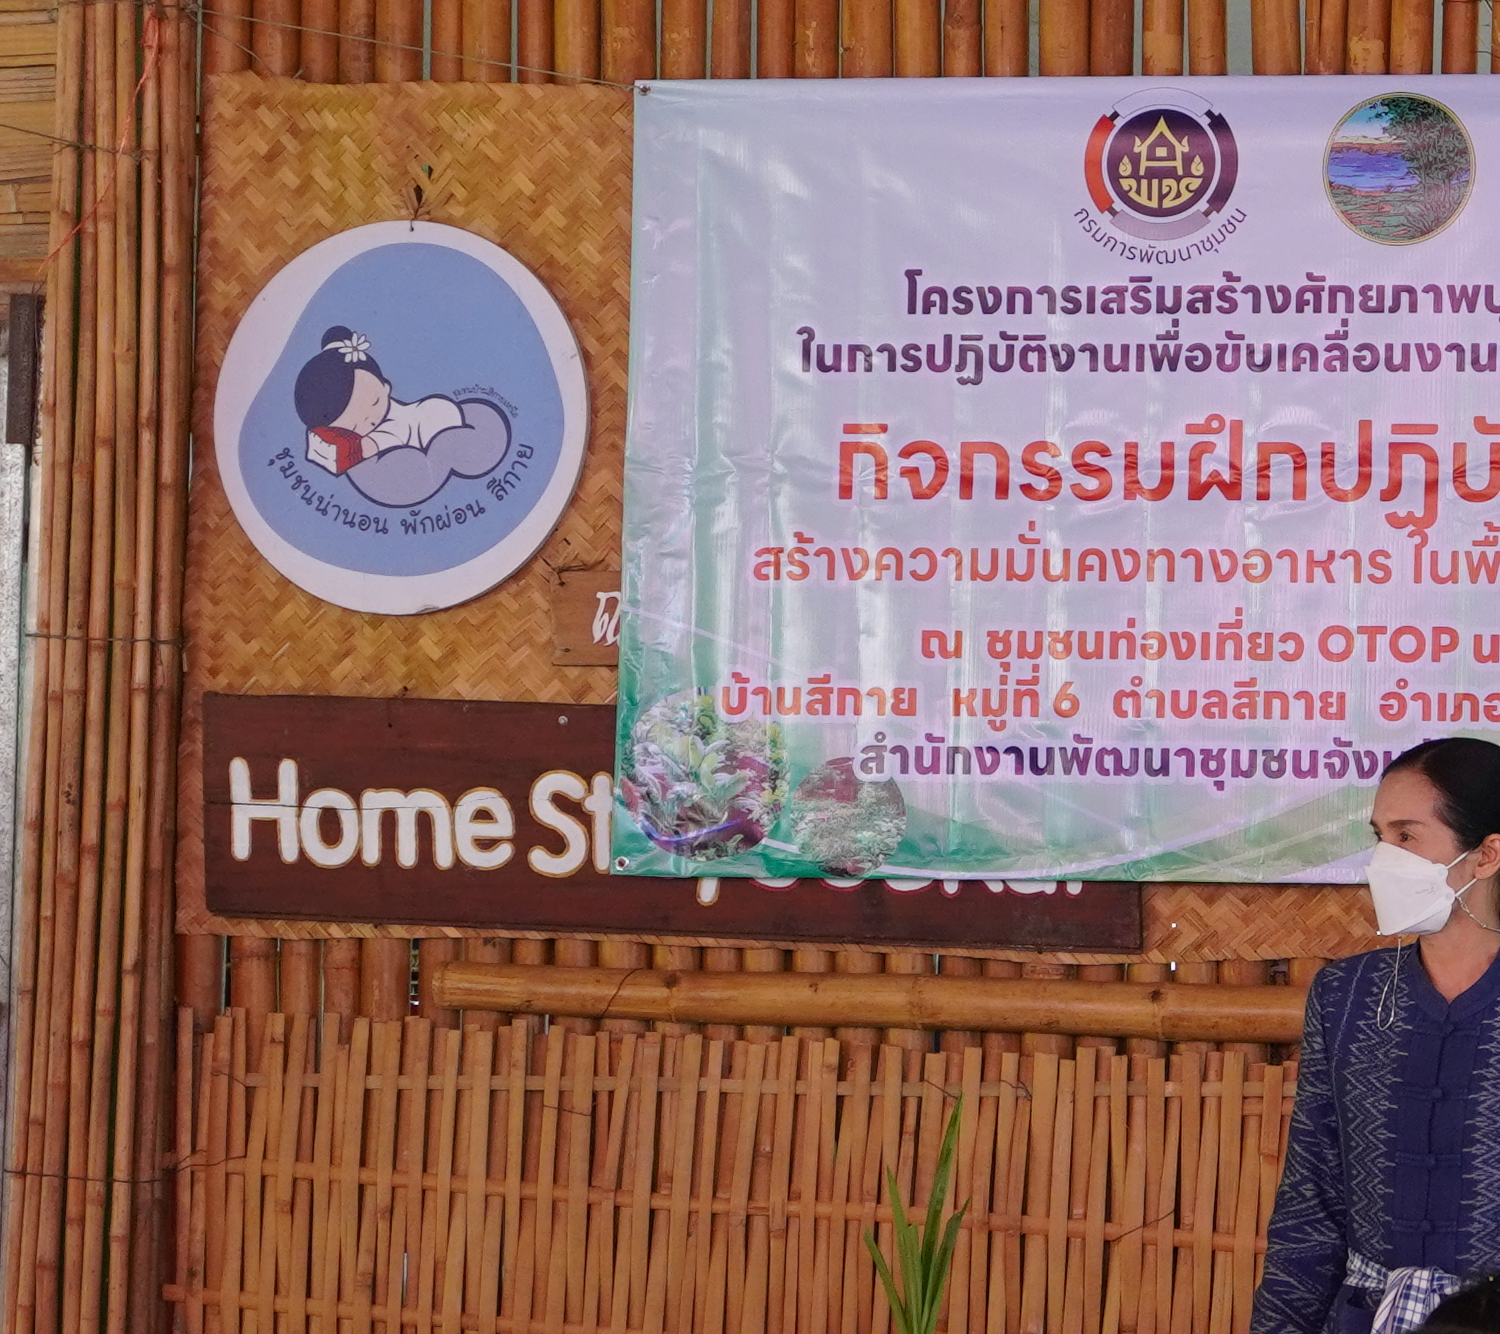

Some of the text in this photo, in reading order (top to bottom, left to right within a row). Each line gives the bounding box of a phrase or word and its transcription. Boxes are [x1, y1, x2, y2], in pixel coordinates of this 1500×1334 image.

[1074, 207, 1248, 264] กรมการพัฒนาชุมชน
[268, 443, 535, 536] ชุมชนน่านอน พักผ่อน สีกาย
[752, 520, 1392, 585] สร้างความมั่นคงทางอาหาร
[920, 629, 963, 660] ณ
[986, 607, 1304, 671] ชุมชนท่องเที่ยว
[1317, 624, 1460, 664] OTOP
[721, 672, 918, 718] บ้านสีกาย
[952, 664, 1041, 732] หมู่ที่
[1052, 680, 1081, 719] 6
[1112, 675, 1346, 723] ตำบลสีกาย
[229, 756, 614, 878] Home St
